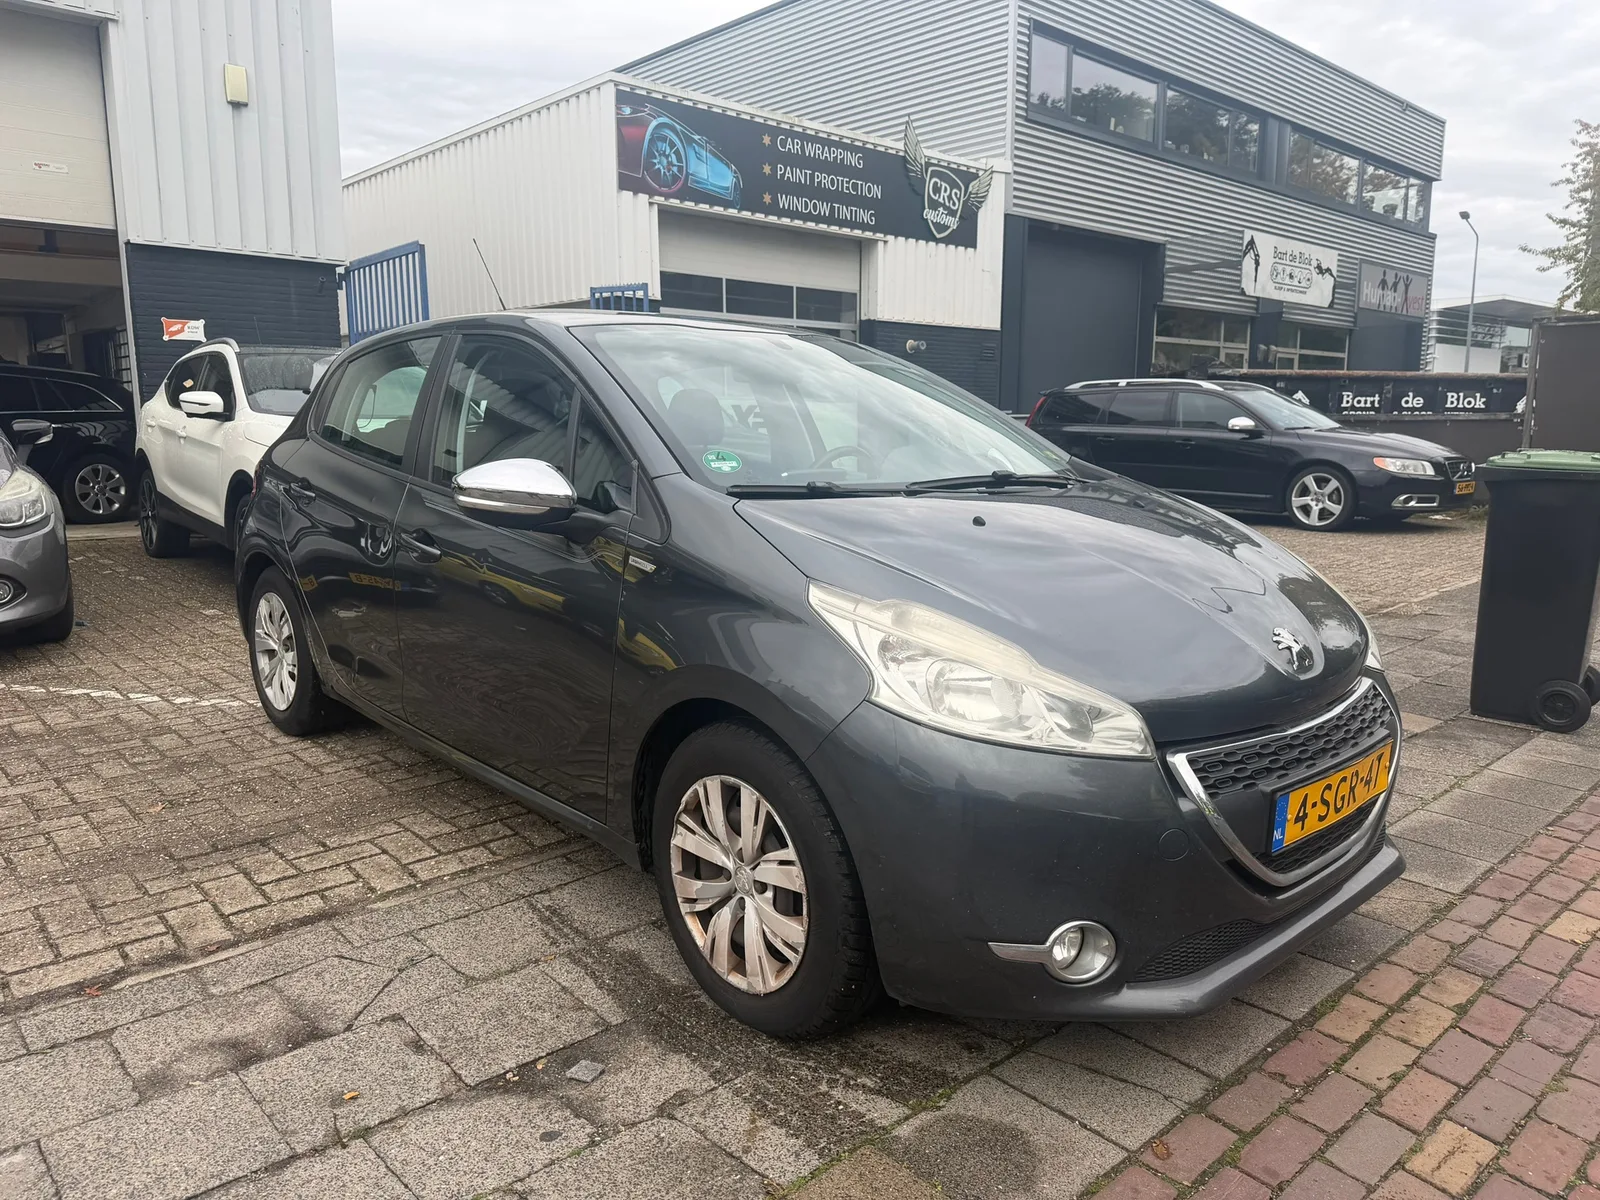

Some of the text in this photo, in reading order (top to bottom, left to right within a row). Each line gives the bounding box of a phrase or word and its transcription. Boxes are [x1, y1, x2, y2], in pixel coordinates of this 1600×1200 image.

[777, 135, 864, 169] CAR WRAPPING
[777, 164, 882, 200] PAINT PROTECTION
[929, 177, 961, 210] CRS
[777, 193, 876, 226] WINDOW TINTING
[923, 206, 959, 230] customs
[1273, 245, 1313, 267] Bart de Blok
[1340, 391, 1487, 409] Bart de Blok
[1293, 751, 1385, 831] 4-SGR-47
[1272, 827, 1284, 842] NL
